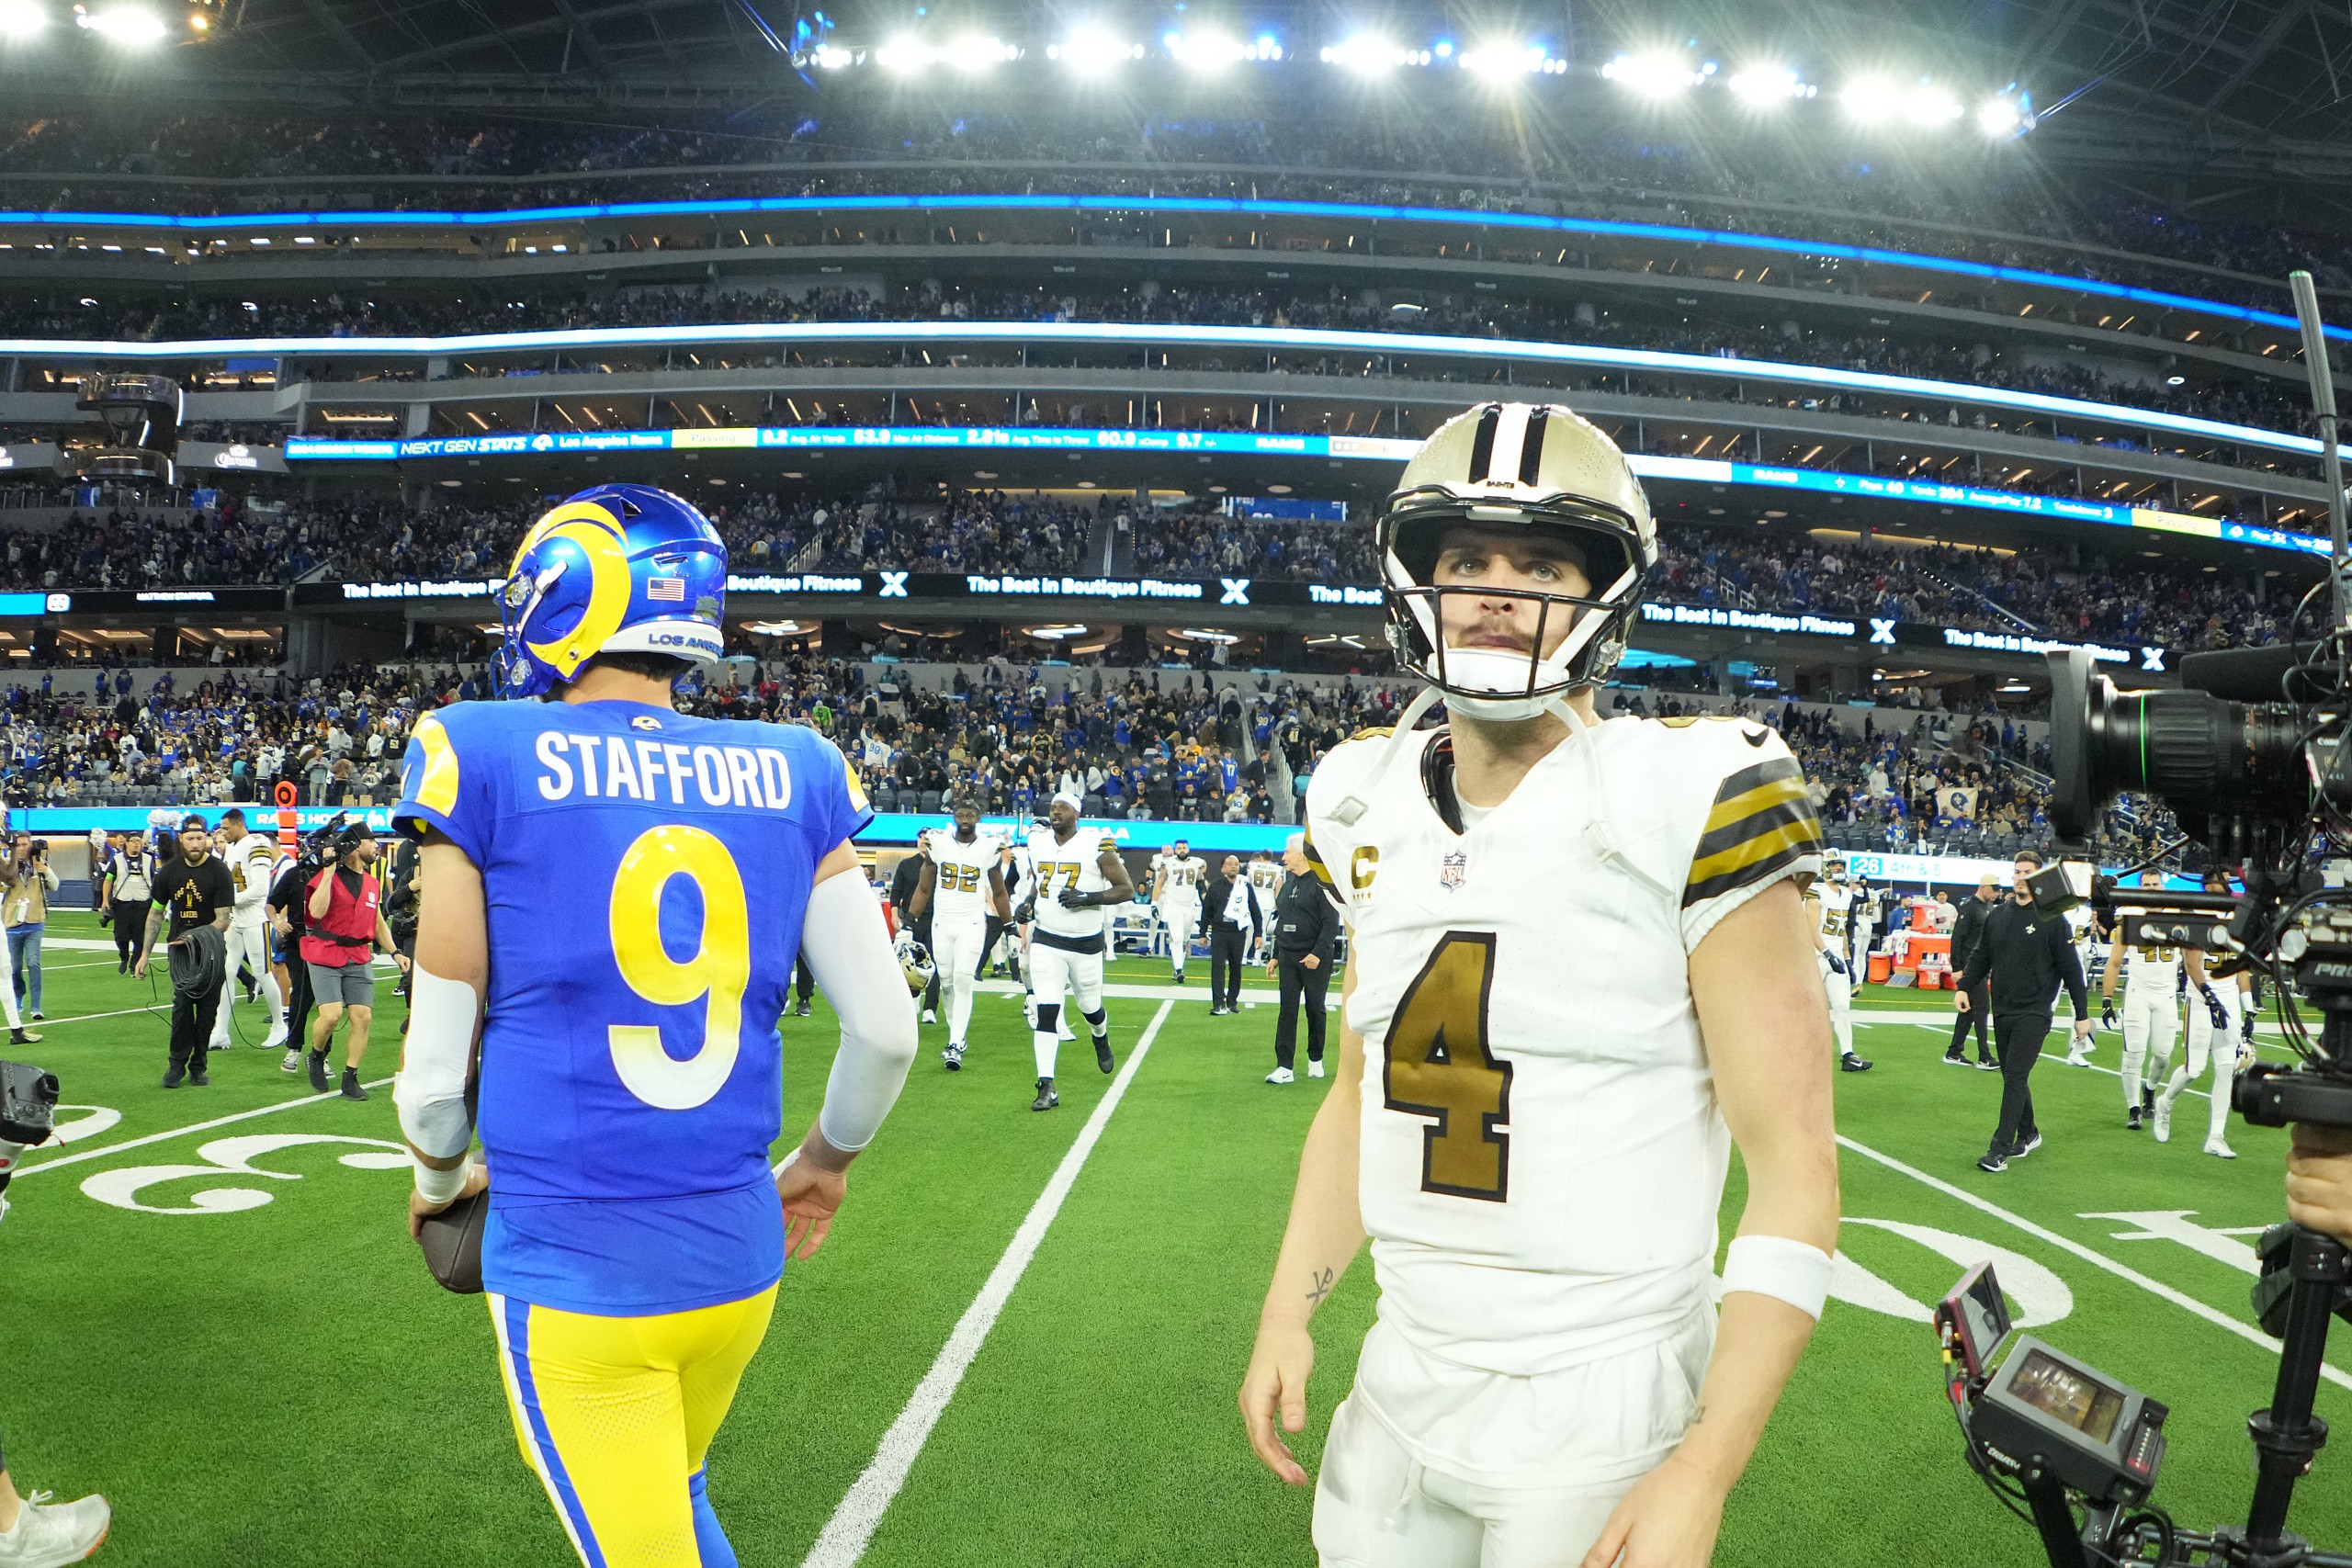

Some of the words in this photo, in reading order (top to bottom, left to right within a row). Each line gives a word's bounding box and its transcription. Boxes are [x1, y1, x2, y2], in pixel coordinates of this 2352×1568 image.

[401, 441, 443, 455] NEXT
[445, 439, 478, 453] GEN
[478, 436, 526, 452] STATS
[691, 434, 736, 444] Passing
[2157, 515, 2198, 532] Passing
[343, 583, 369, 598] The
[370, 581, 402, 597] Best
[403, 581, 419, 596] in
[420, 580, 487, 597] Boutique
[727, 574, 800, 593] Boutique
[803, 575, 862, 592] Fitness
[967, 575, 1000, 592] The
[1001, 576, 1039, 593] Best
[1041, 577, 1059, 593] in
[1061, 578, 1139, 599] Boutique
[1141, 580, 1202, 598] Fitness
[1309, 584, 1342, 603] The
[1344, 586, 1383, 605] Best
[1642, 603, 1673, 621] The
[1674, 605, 1710, 625] Best
[1712, 608, 1727, 626] in
[1729, 609, 1800, 633] Boutique
[1800, 615, 1855, 636] Fitness
[649, 633, 684, 647] LOS
[1944, 628, 1973, 646] The
[1973, 631, 2004, 649] Best
[2006, 635, 2020, 650] in
[535, 731, 792, 810] STAFFORD
[256, 812, 306, 825] RAS
[1351, 845, 1380, 890] C
[1442, 866, 1461, 883] NFL
[1853, 858, 1880, 874] :26
[1890, 862, 1913, 873] 4th
[1918, 863, 1928, 875] &
[940, 861, 981, 893] 92
[1037, 861, 1081, 899] 77
[1172, 868, 1196, 886] 78
[1253, 872, 1278, 889] 87
[609, 824, 751, 1111] 9
[1384, 931, 1514, 1203] 4
